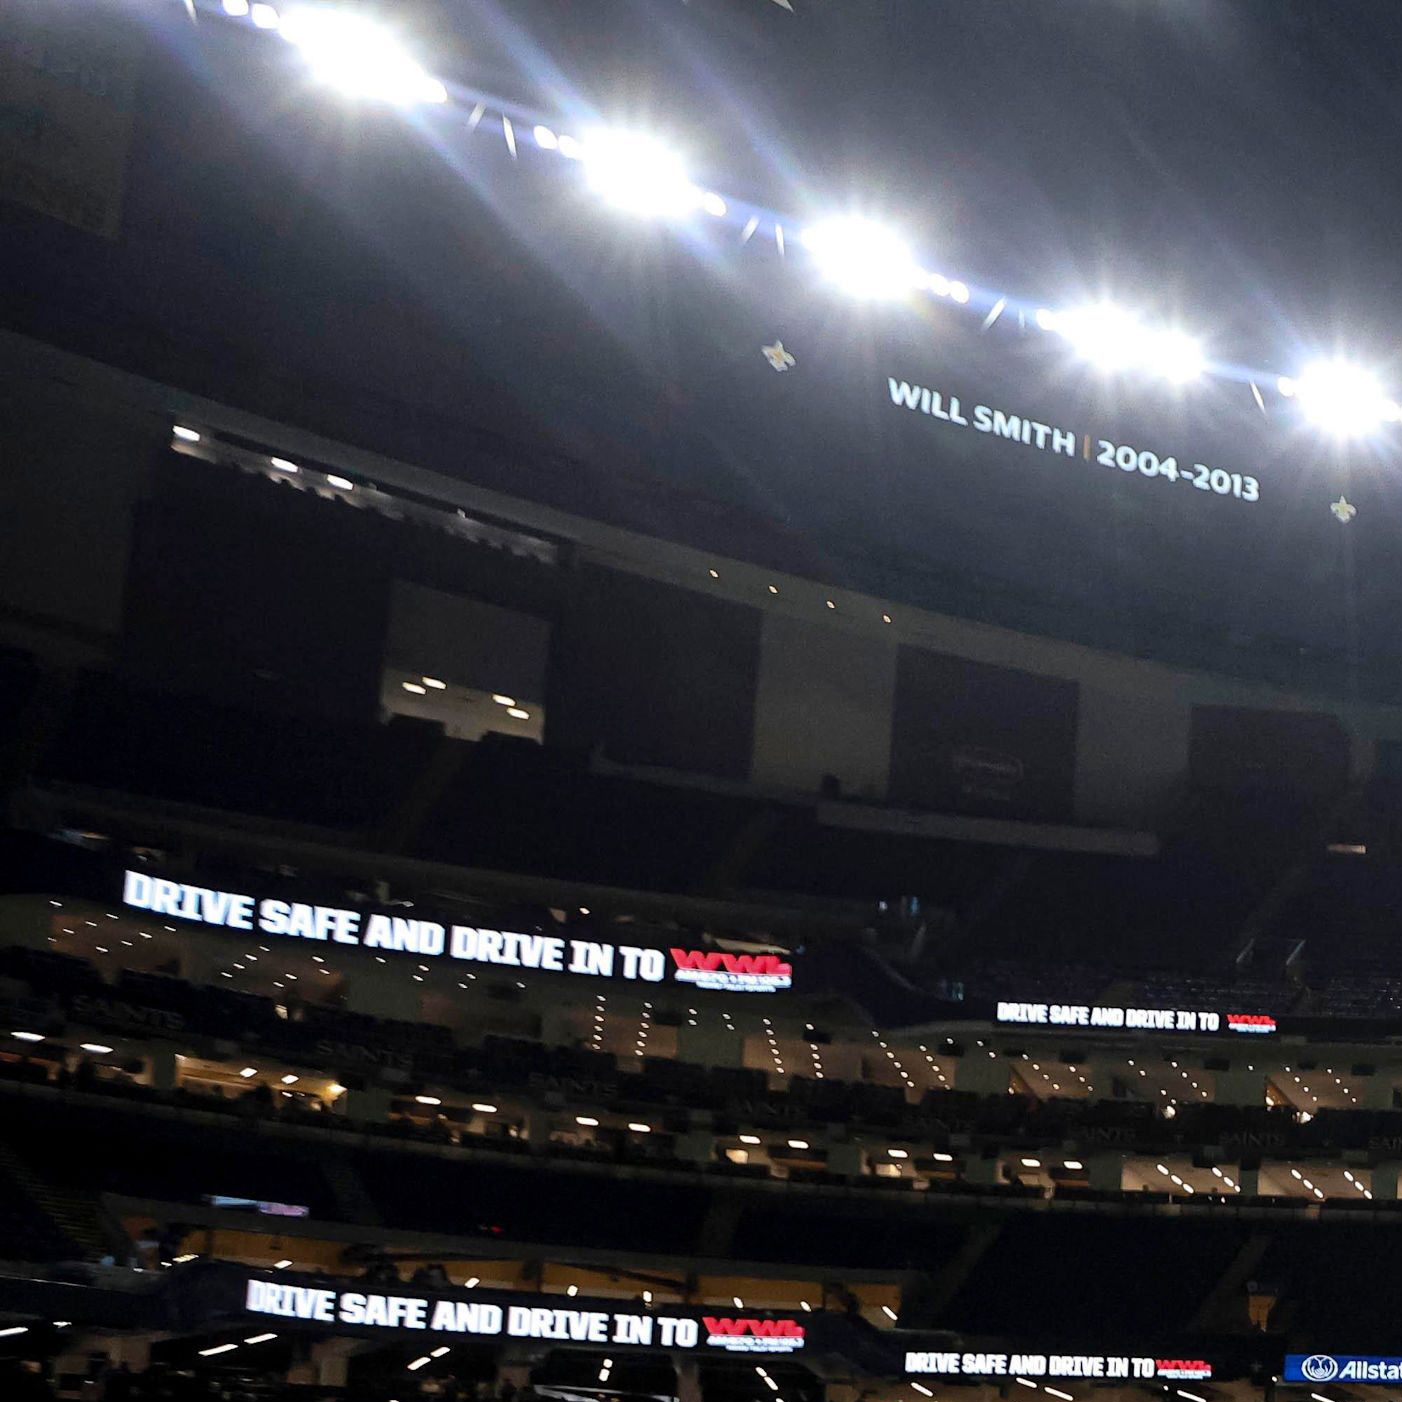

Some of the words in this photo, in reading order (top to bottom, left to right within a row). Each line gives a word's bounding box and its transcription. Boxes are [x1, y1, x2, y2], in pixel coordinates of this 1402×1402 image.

[888, 377, 968, 426] WILL
[973, 405, 1076, 457] SMITH
[1097, 440, 1260, 501] 2004-2013
[123, 869, 255, 931] DRIVE
[258, 898, 361, 945] SAFE
[363, 913, 446, 956] AND
[450, 925, 566, 971] DRIVE
[568, 939, 615, 977] IN
[619, 945, 665, 982] TO
[996, 1001, 1049, 1023] DRIVE
[1048, 1004, 1090, 1026] SAFE
[1090, 1006, 1125, 1027] AND
[1125, 1008, 1176, 1029] DRIVE
[1175, 1010, 1197, 1031] IN
[1197, 1011, 1220, 1031] TO
[246, 1279, 337, 1322] DRIVE
[339, 1292, 428, 1330] SAFE
[430, 1300, 503, 1335] AND
[507, 1306, 609, 1342] DRIVE
[612, 1313, 653, 1345] IN
[657, 1316, 699, 1348] TO
[904, 1351, 961, 1374] DRIVE
[961, 1353, 1008, 1375] SAFE
[1008, 1354, 1047, 1375] AND
[1048, 1355, 1105, 1377] DRIVE
[1105, 1356, 1129, 1378] IN
[1130, 1357, 1155, 1378] TO
